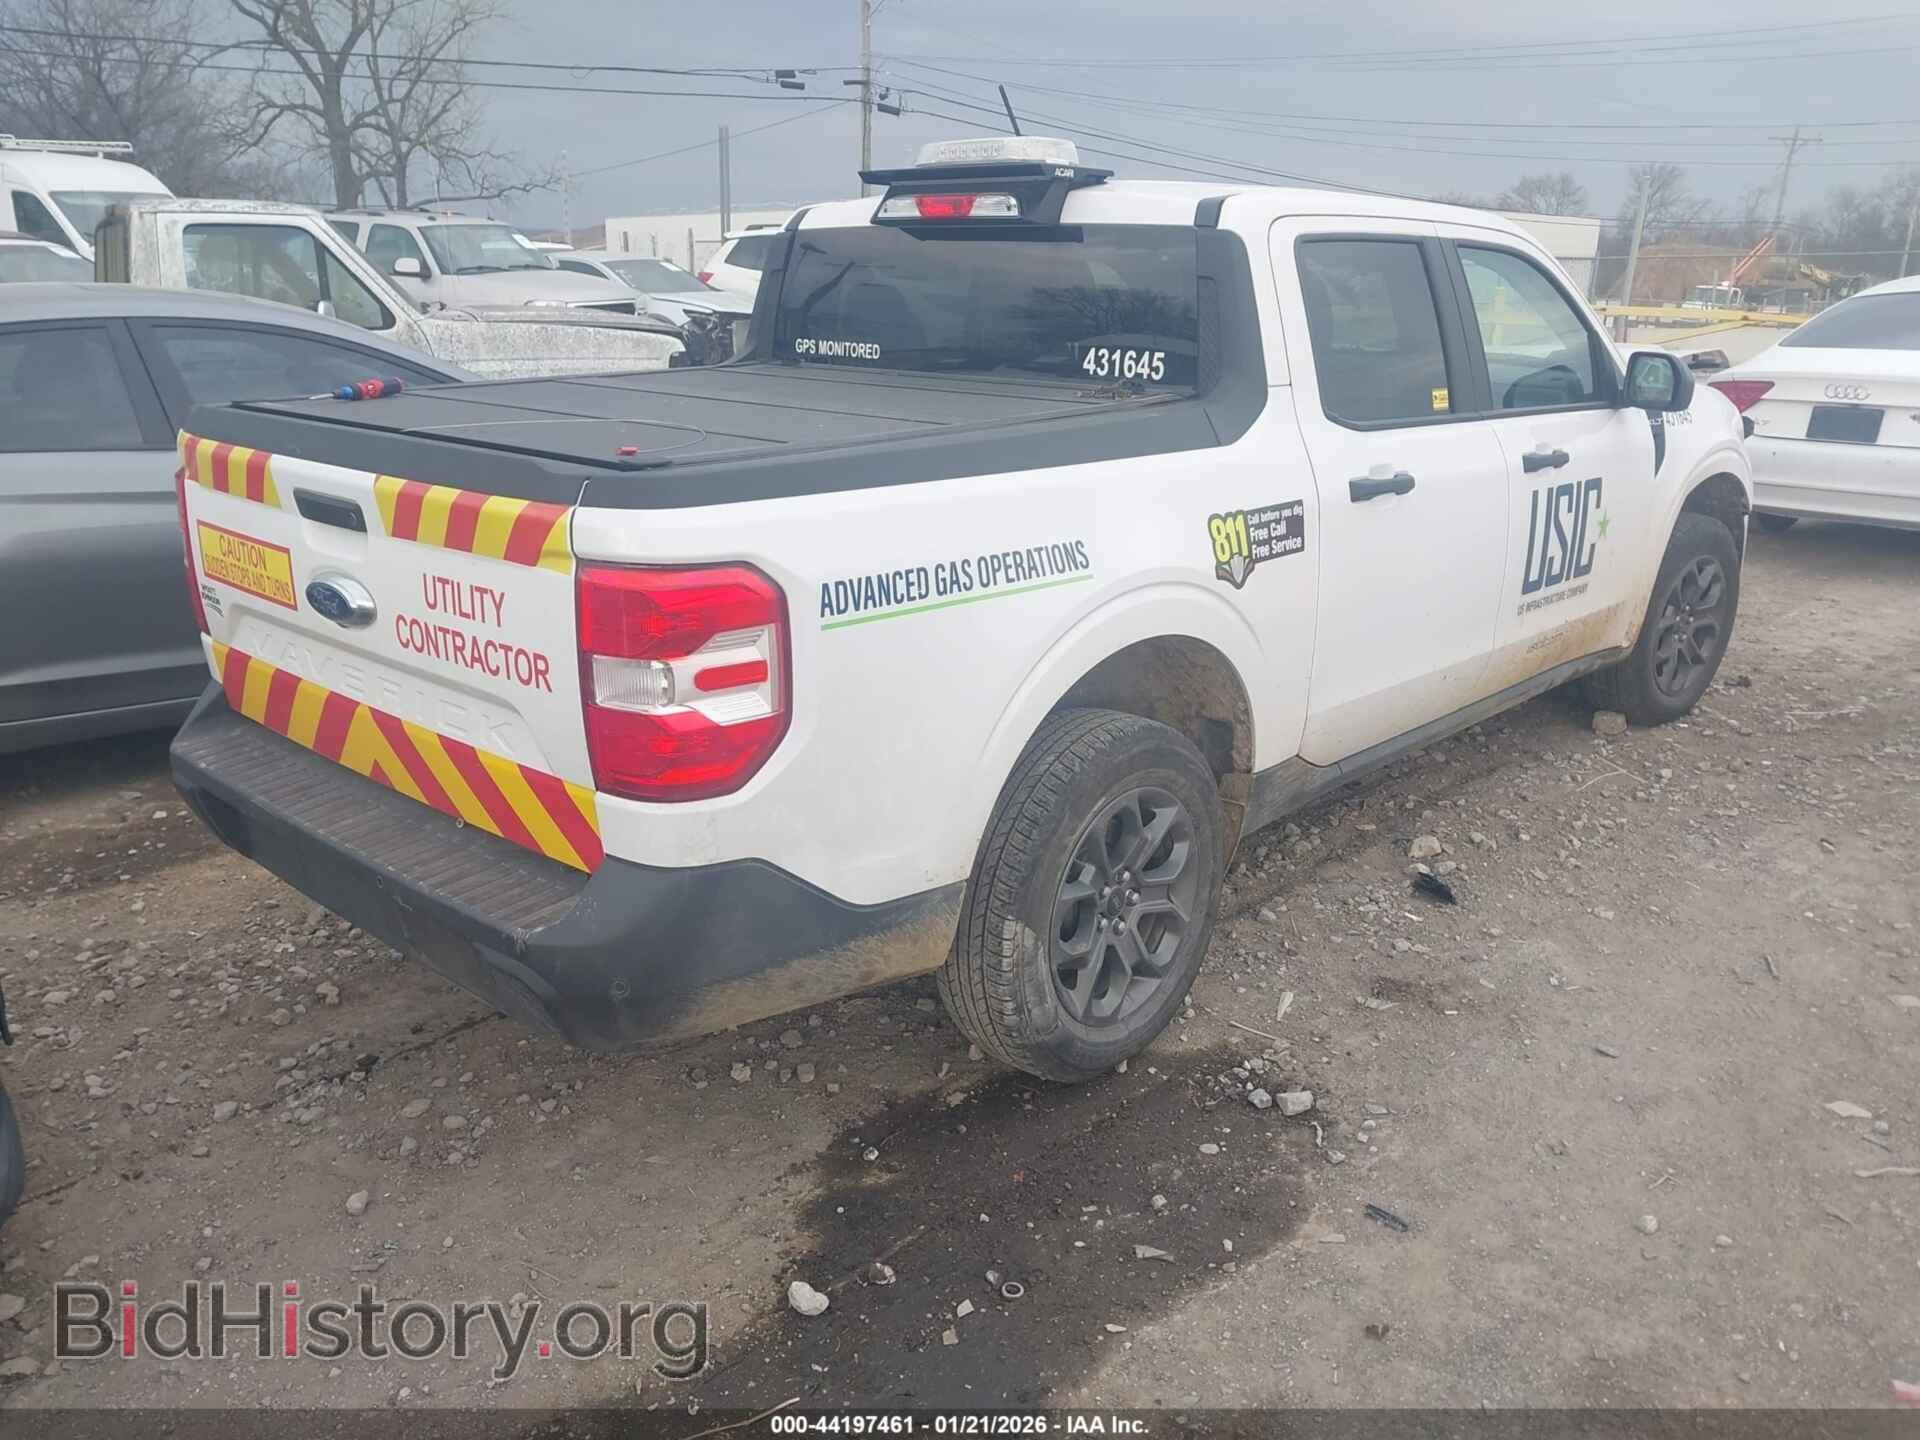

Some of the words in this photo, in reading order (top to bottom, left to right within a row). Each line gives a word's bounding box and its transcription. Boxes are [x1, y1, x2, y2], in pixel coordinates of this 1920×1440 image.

[795, 338, 816, 354] GPS
[818, 340, 880, 359] MONITORED
[1082, 347, 1165, 381] 431645
[1247, 513, 1260, 525] Call
[1260, 510, 1280, 522] before
[1280, 507, 1293, 519] you
[1293, 504, 1303, 516] dig
[1249, 527, 1270, 542] Free
[1270, 520, 1287, 537] Call
[219, 534, 268, 572] CAUTION
[1209, 512, 1249, 562] 811
[1251, 544, 1271, 560] Free
[1271, 535, 1303, 554] Service
[1521, 477, 1603, 595] USIC
[266, 574, 292, 603] TURNS
[820, 566, 930, 618] ADVANCED
[934, 558, 974, 597] GAS
[977, 540, 1090, 588] OPERATIONS
[422, 573, 505, 628] UTILITY
[395, 613, 553, 693] CONTRACTOR
